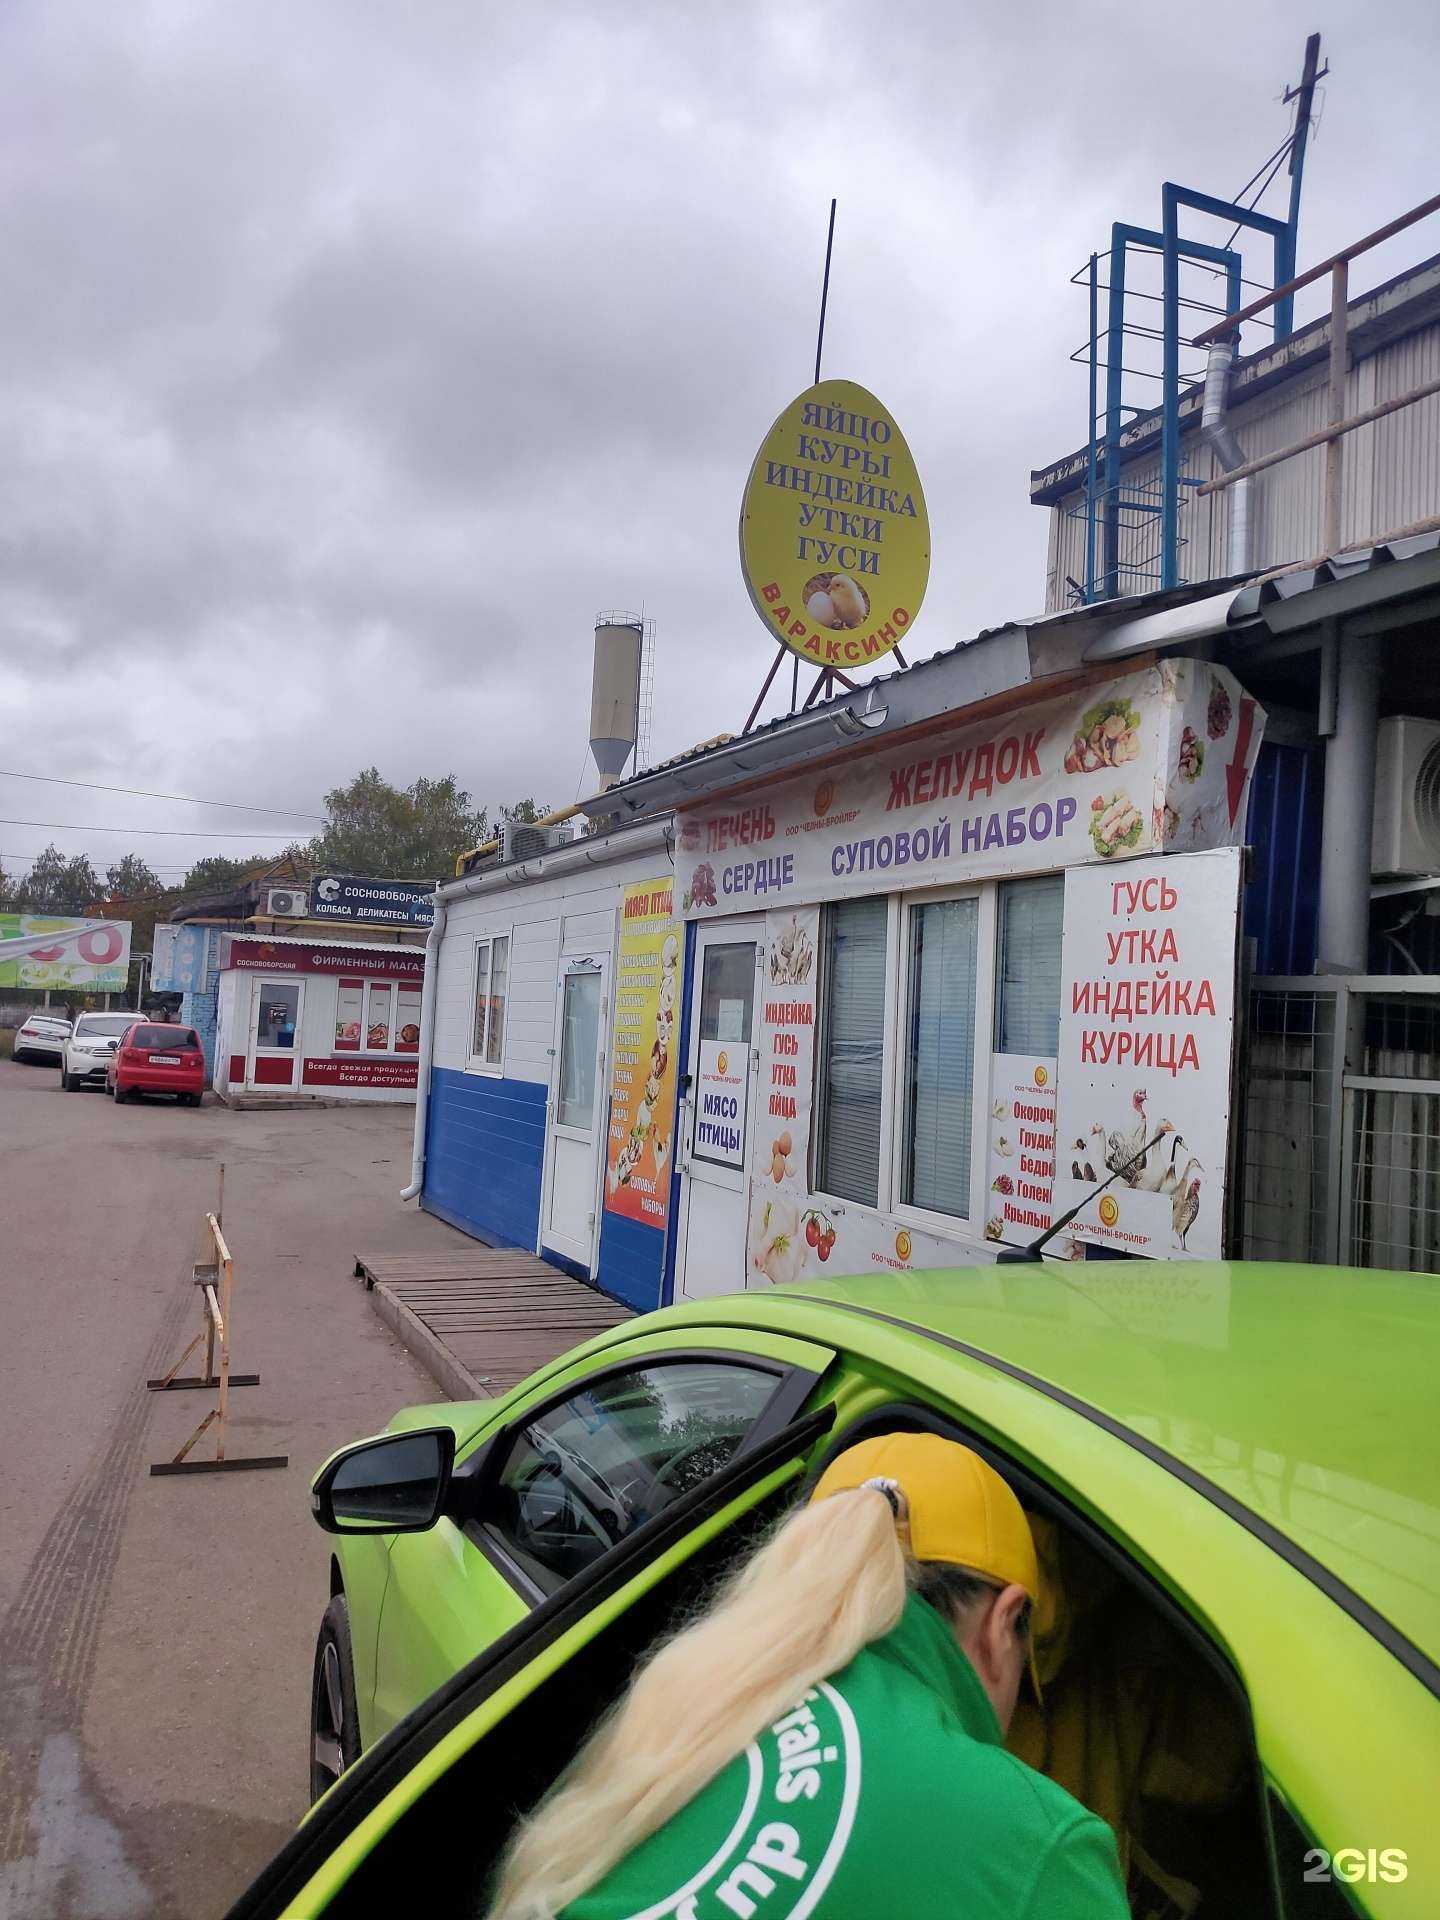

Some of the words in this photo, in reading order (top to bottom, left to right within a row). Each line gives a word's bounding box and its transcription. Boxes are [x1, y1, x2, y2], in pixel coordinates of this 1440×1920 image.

[801, 402, 891, 445] ЯЙЦО
[797, 433, 891, 479] КУРЫ
[765, 460, 917, 518] ИНДЕЙКА
[799, 502, 884, 543] УТКИ
[797, 536, 880, 575] ГУСИ
[761, 582, 910, 662] ВАРАКСИНО
[886, 728, 1046, 811] ЖЕЛУДОК
[706, 805, 775, 853] ПЕЧЕНЬ
[831, 815, 950, 876] СУПОВОЙ
[961, 797, 1077, 854] НАБОР
[722, 854, 794, 895] СЕРДЦЕ
[316, 904, 352, 915] КОЛБАСА
[357, 907, 408, 920] ДЕЛИКАТЕСЫ
[345, 887, 434, 905] СОСНОВОБОРСК
[1112, 876, 1178, 916] ГУСЬ
[236, 959, 296, 969] СОСНОВОБОРСКАЯ
[312, 954, 385, 969] ФИРМЕННЫЙ
[1107, 928, 1179, 966] УТКА
[765, 1000, 813, 1026] ИНДЕЙКА
[1072, 970, 1216, 1023] ИНДЕЙКА
[773, 1033, 798, 1056] ГУСЬ
[1081, 1030, 1200, 1078] КУРИЦА
[308, 1061, 337, 1071] Всегда
[340, 1064, 371, 1072] свежая
[339, 1073, 368, 1081] Всегда
[772, 1063, 796, 1087] УТКА
[703, 1093, 737, 1121] МЯСО
[768, 1091, 796, 1121] ЯЙЦА
[698, 1122, 740, 1150] ПТИЦЫ
[1068, 1221, 1085, 1232] ООО
[772, 1687, 838, 1803] rais
